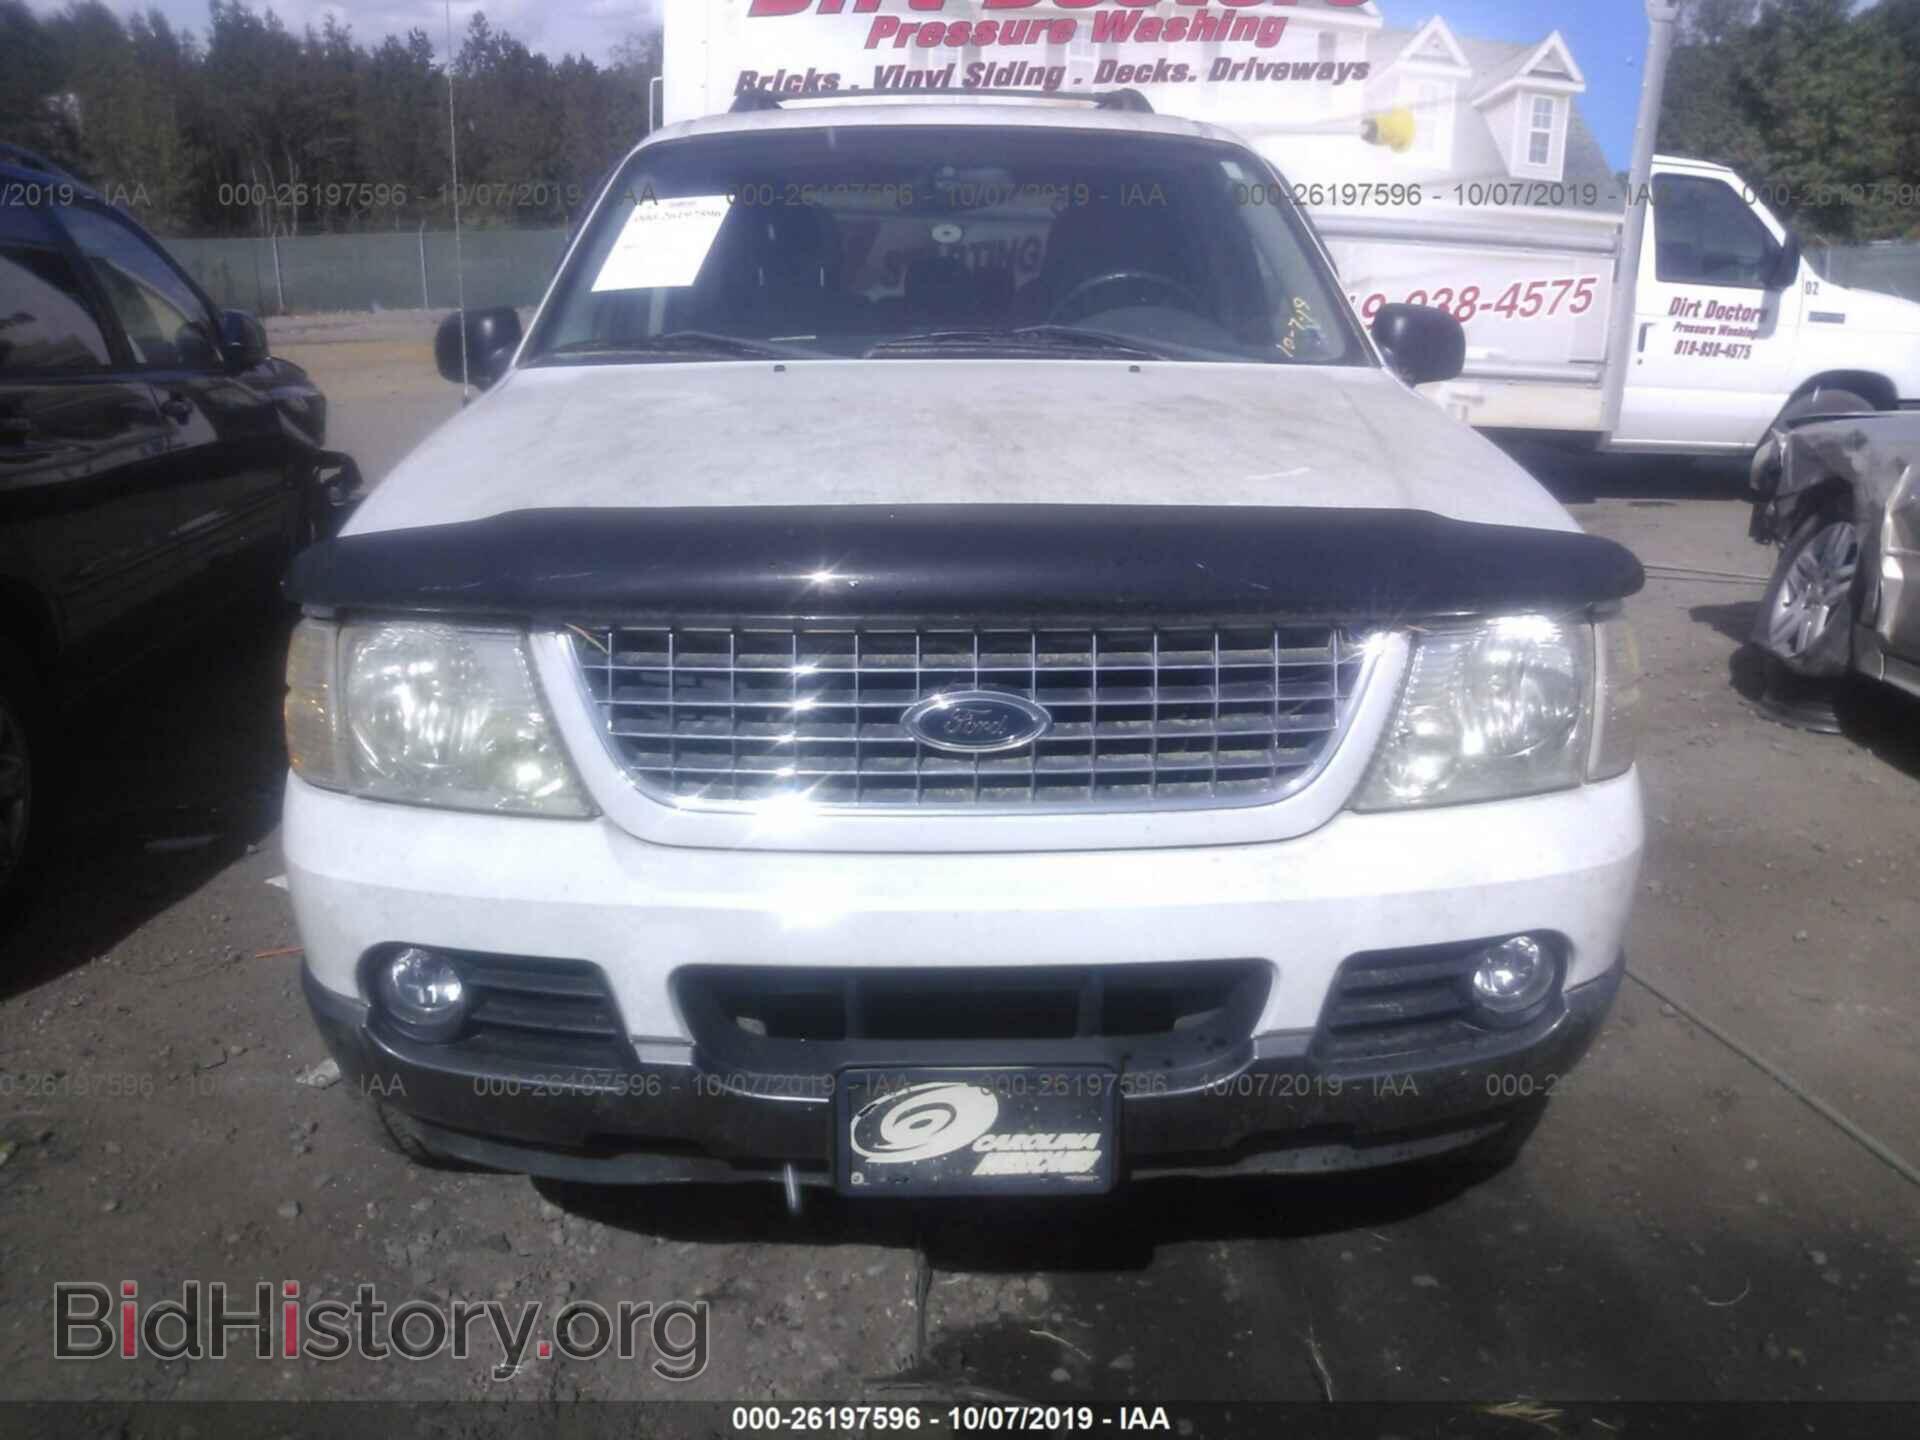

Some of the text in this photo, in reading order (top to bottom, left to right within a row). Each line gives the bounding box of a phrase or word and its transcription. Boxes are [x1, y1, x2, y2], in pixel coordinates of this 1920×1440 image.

[864, 10, 1288, 49] Pressure Washing
[734, 67, 841, 96] Bricks
[874, 63, 956, 89] Vinyl
[963, 61, 1066, 91] Siding
[1208, 56, 1370, 86] Driveways
[1668, 297, 1769, 323] Dirt Doctors
